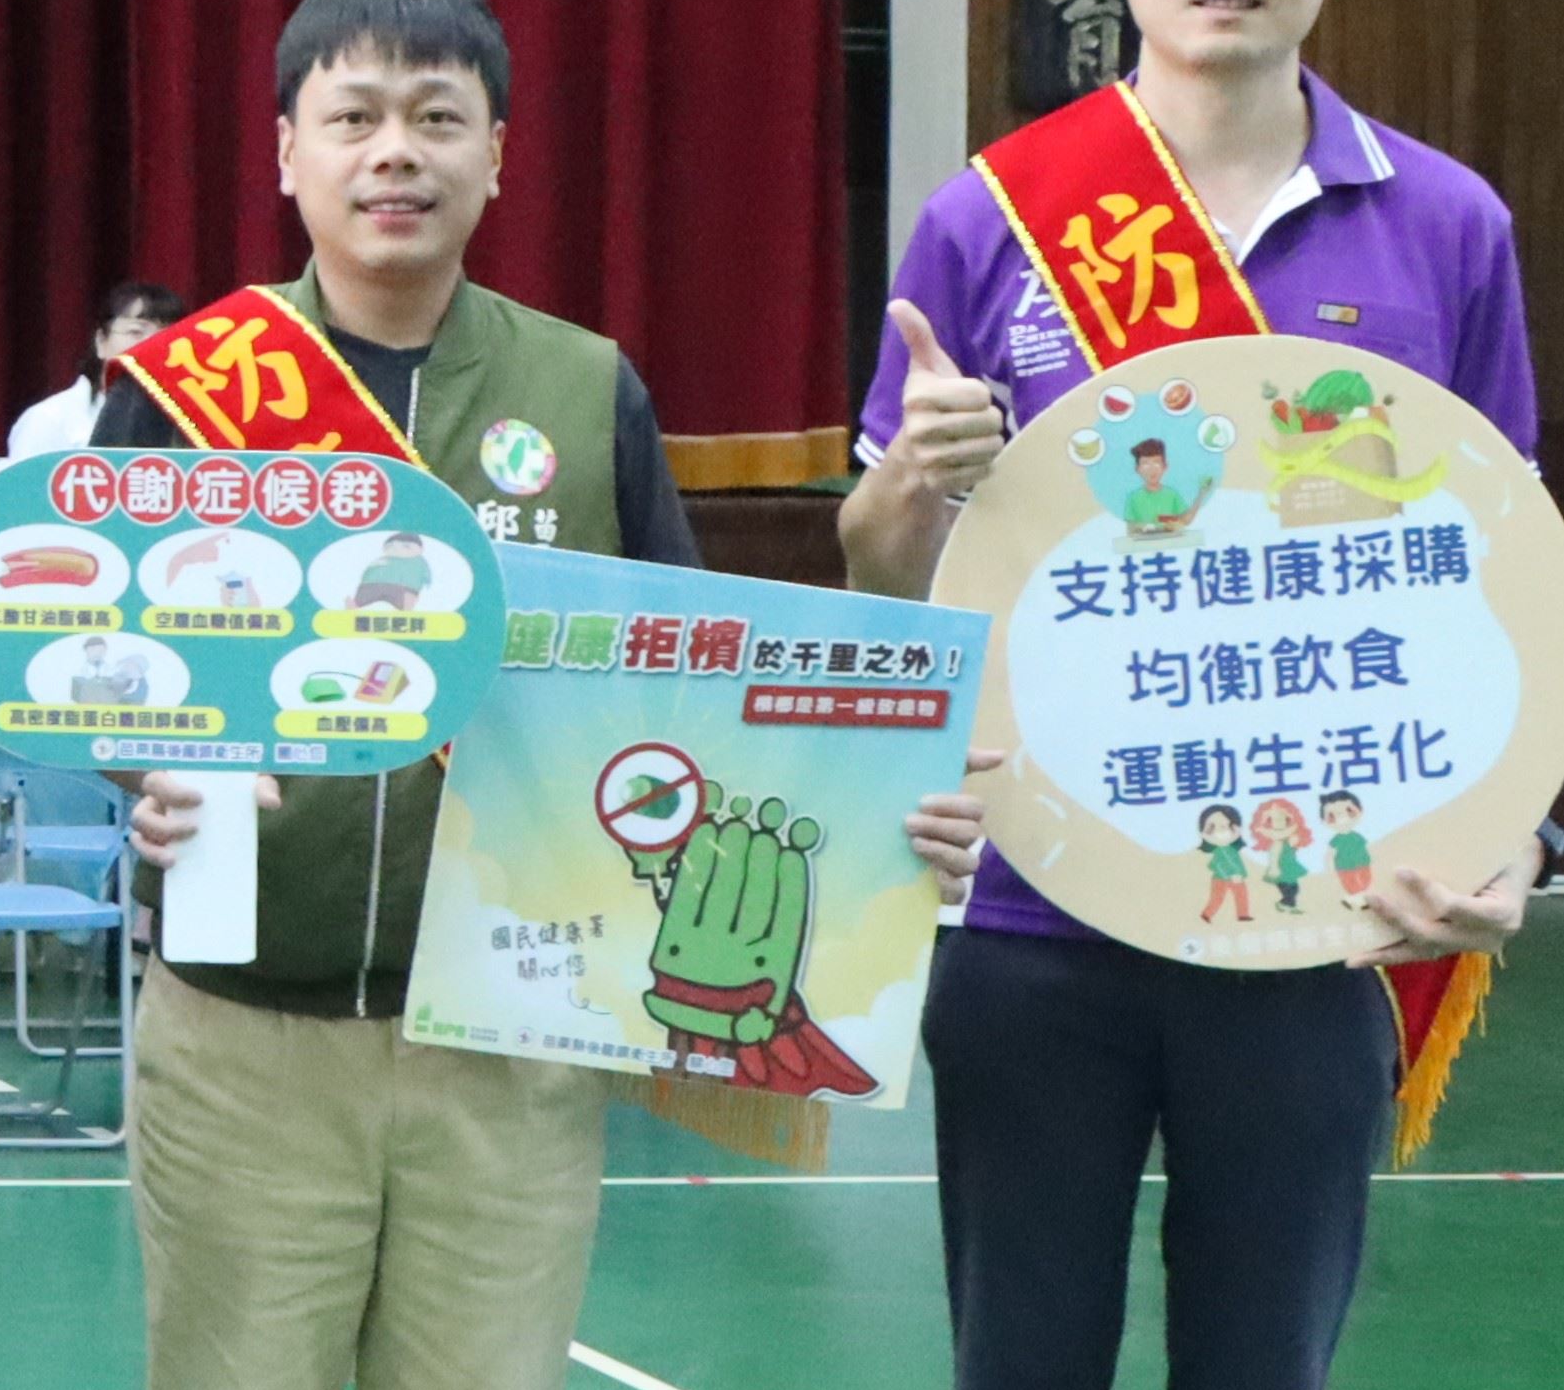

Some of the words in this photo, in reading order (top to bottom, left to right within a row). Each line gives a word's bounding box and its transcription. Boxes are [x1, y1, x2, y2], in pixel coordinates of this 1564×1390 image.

[1059, 192, 1202, 350] 防
[164, 316, 311, 450] 防
[57, 465, 384, 520] 代謝症候群
[1048, 522, 1472, 623] 支持健康採購
[1126, 626, 1409, 710] 均衡飲食
[1103, 718, 1455, 809] 運動生活化
